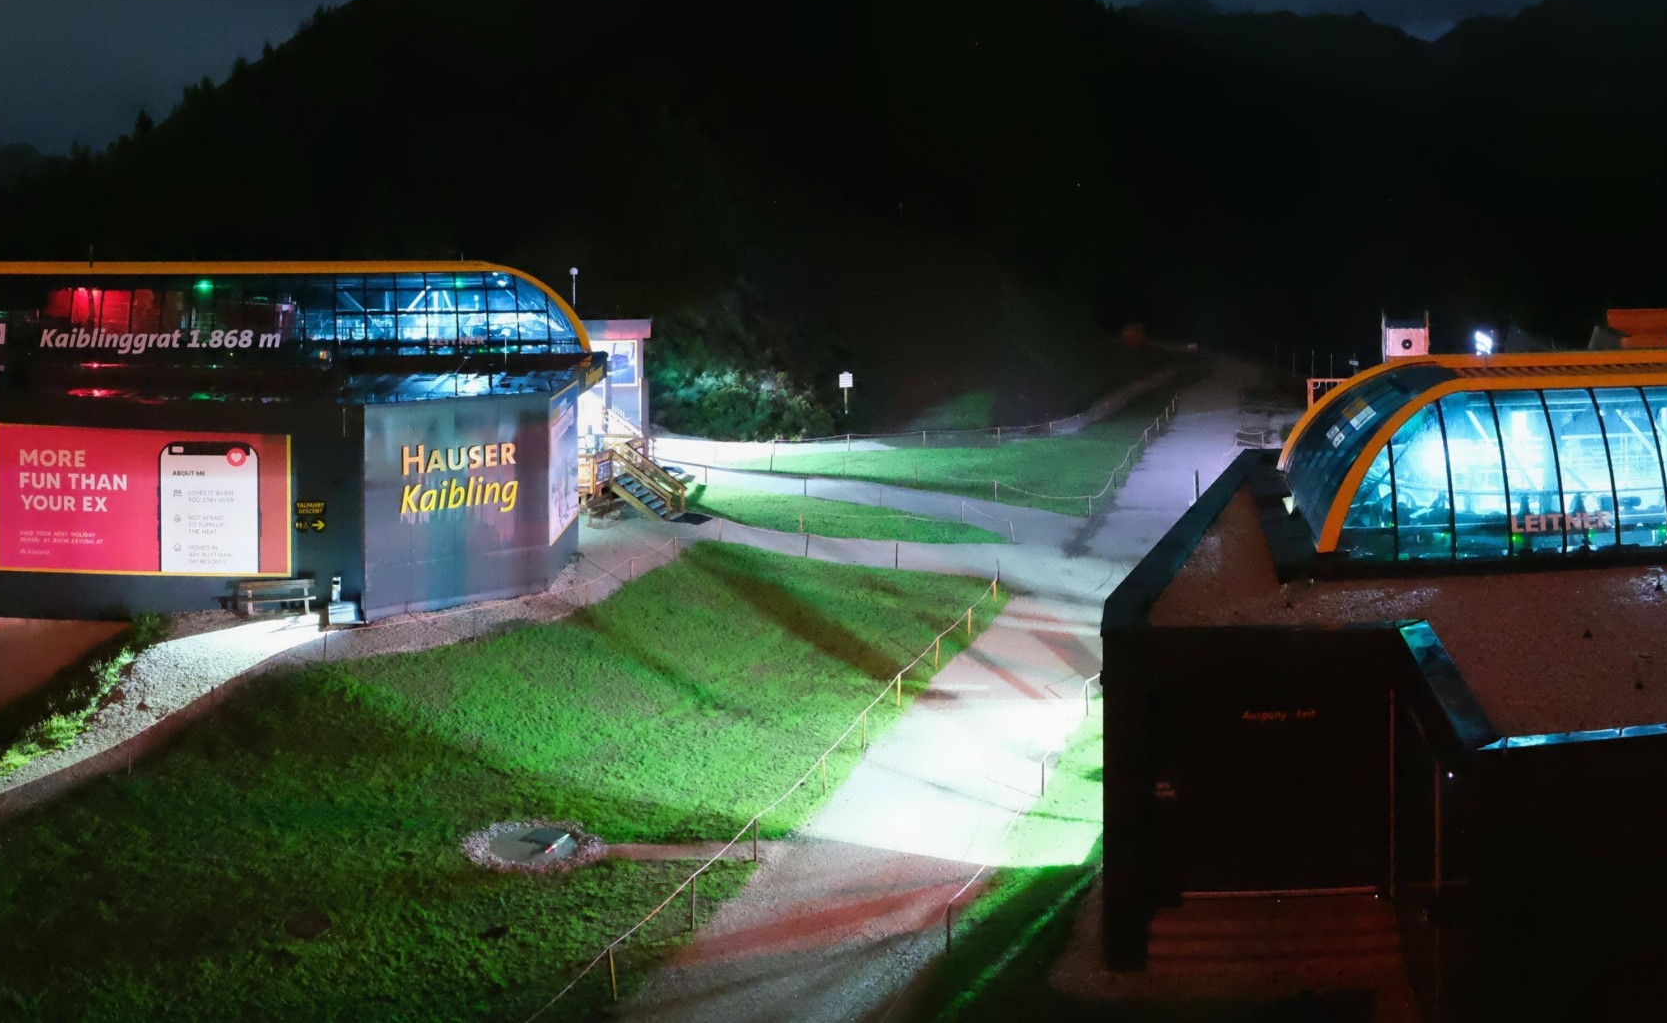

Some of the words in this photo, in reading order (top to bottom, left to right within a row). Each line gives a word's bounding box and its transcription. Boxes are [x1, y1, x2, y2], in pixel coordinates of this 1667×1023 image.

[40, 328, 182, 354] Kaiblinggrat
[186, 329, 254, 348] 1.868
[259, 332, 281, 348] m
[20, 449, 86, 468] MORE
[402, 442, 517, 476] HAUSER
[20, 472, 61, 489] FUN
[68, 473, 128, 491] THAN
[20, 494, 76, 511] YOUR
[82, 496, 108, 512] EX
[400, 476, 519, 513] Kaibling
[1511, 510, 1613, 533] LEITNER
